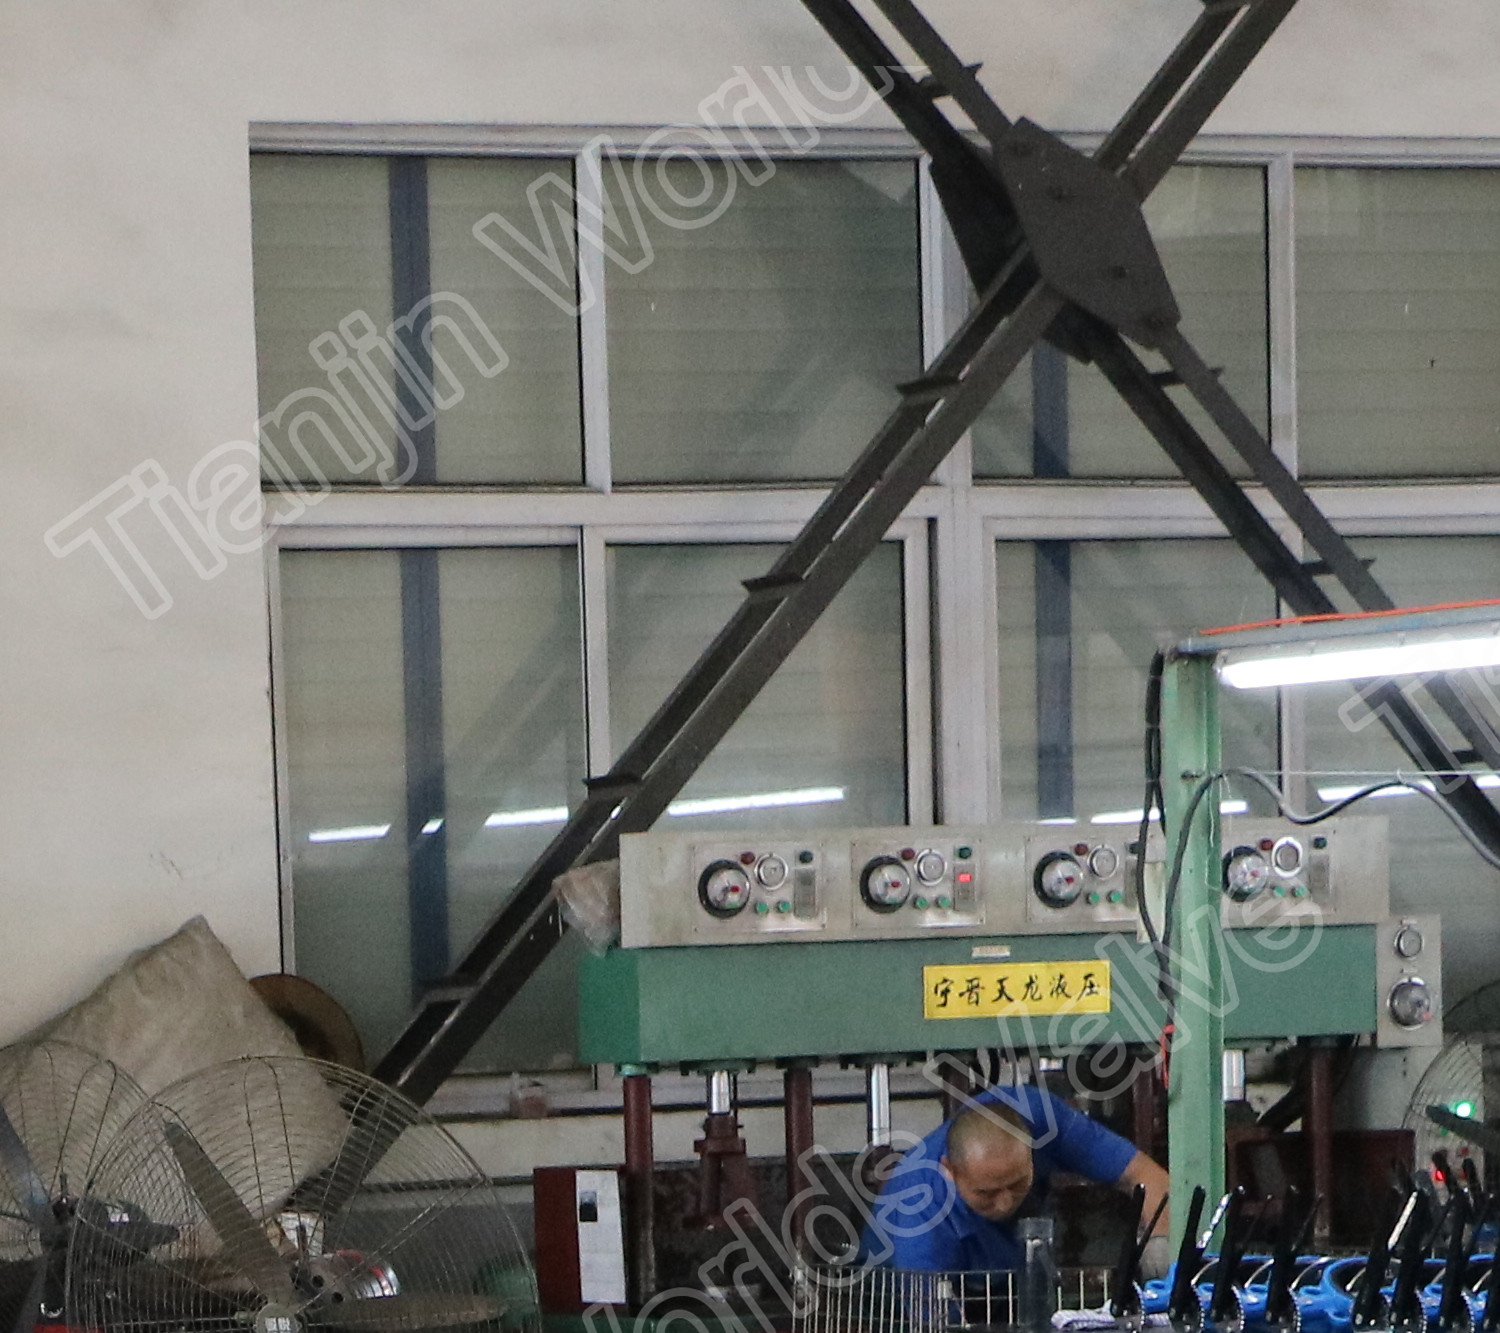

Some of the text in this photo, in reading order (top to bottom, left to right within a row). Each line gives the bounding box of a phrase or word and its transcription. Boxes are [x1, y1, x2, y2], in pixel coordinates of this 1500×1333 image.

[934, 973, 1100, 1008] 宁晋天龙液压
